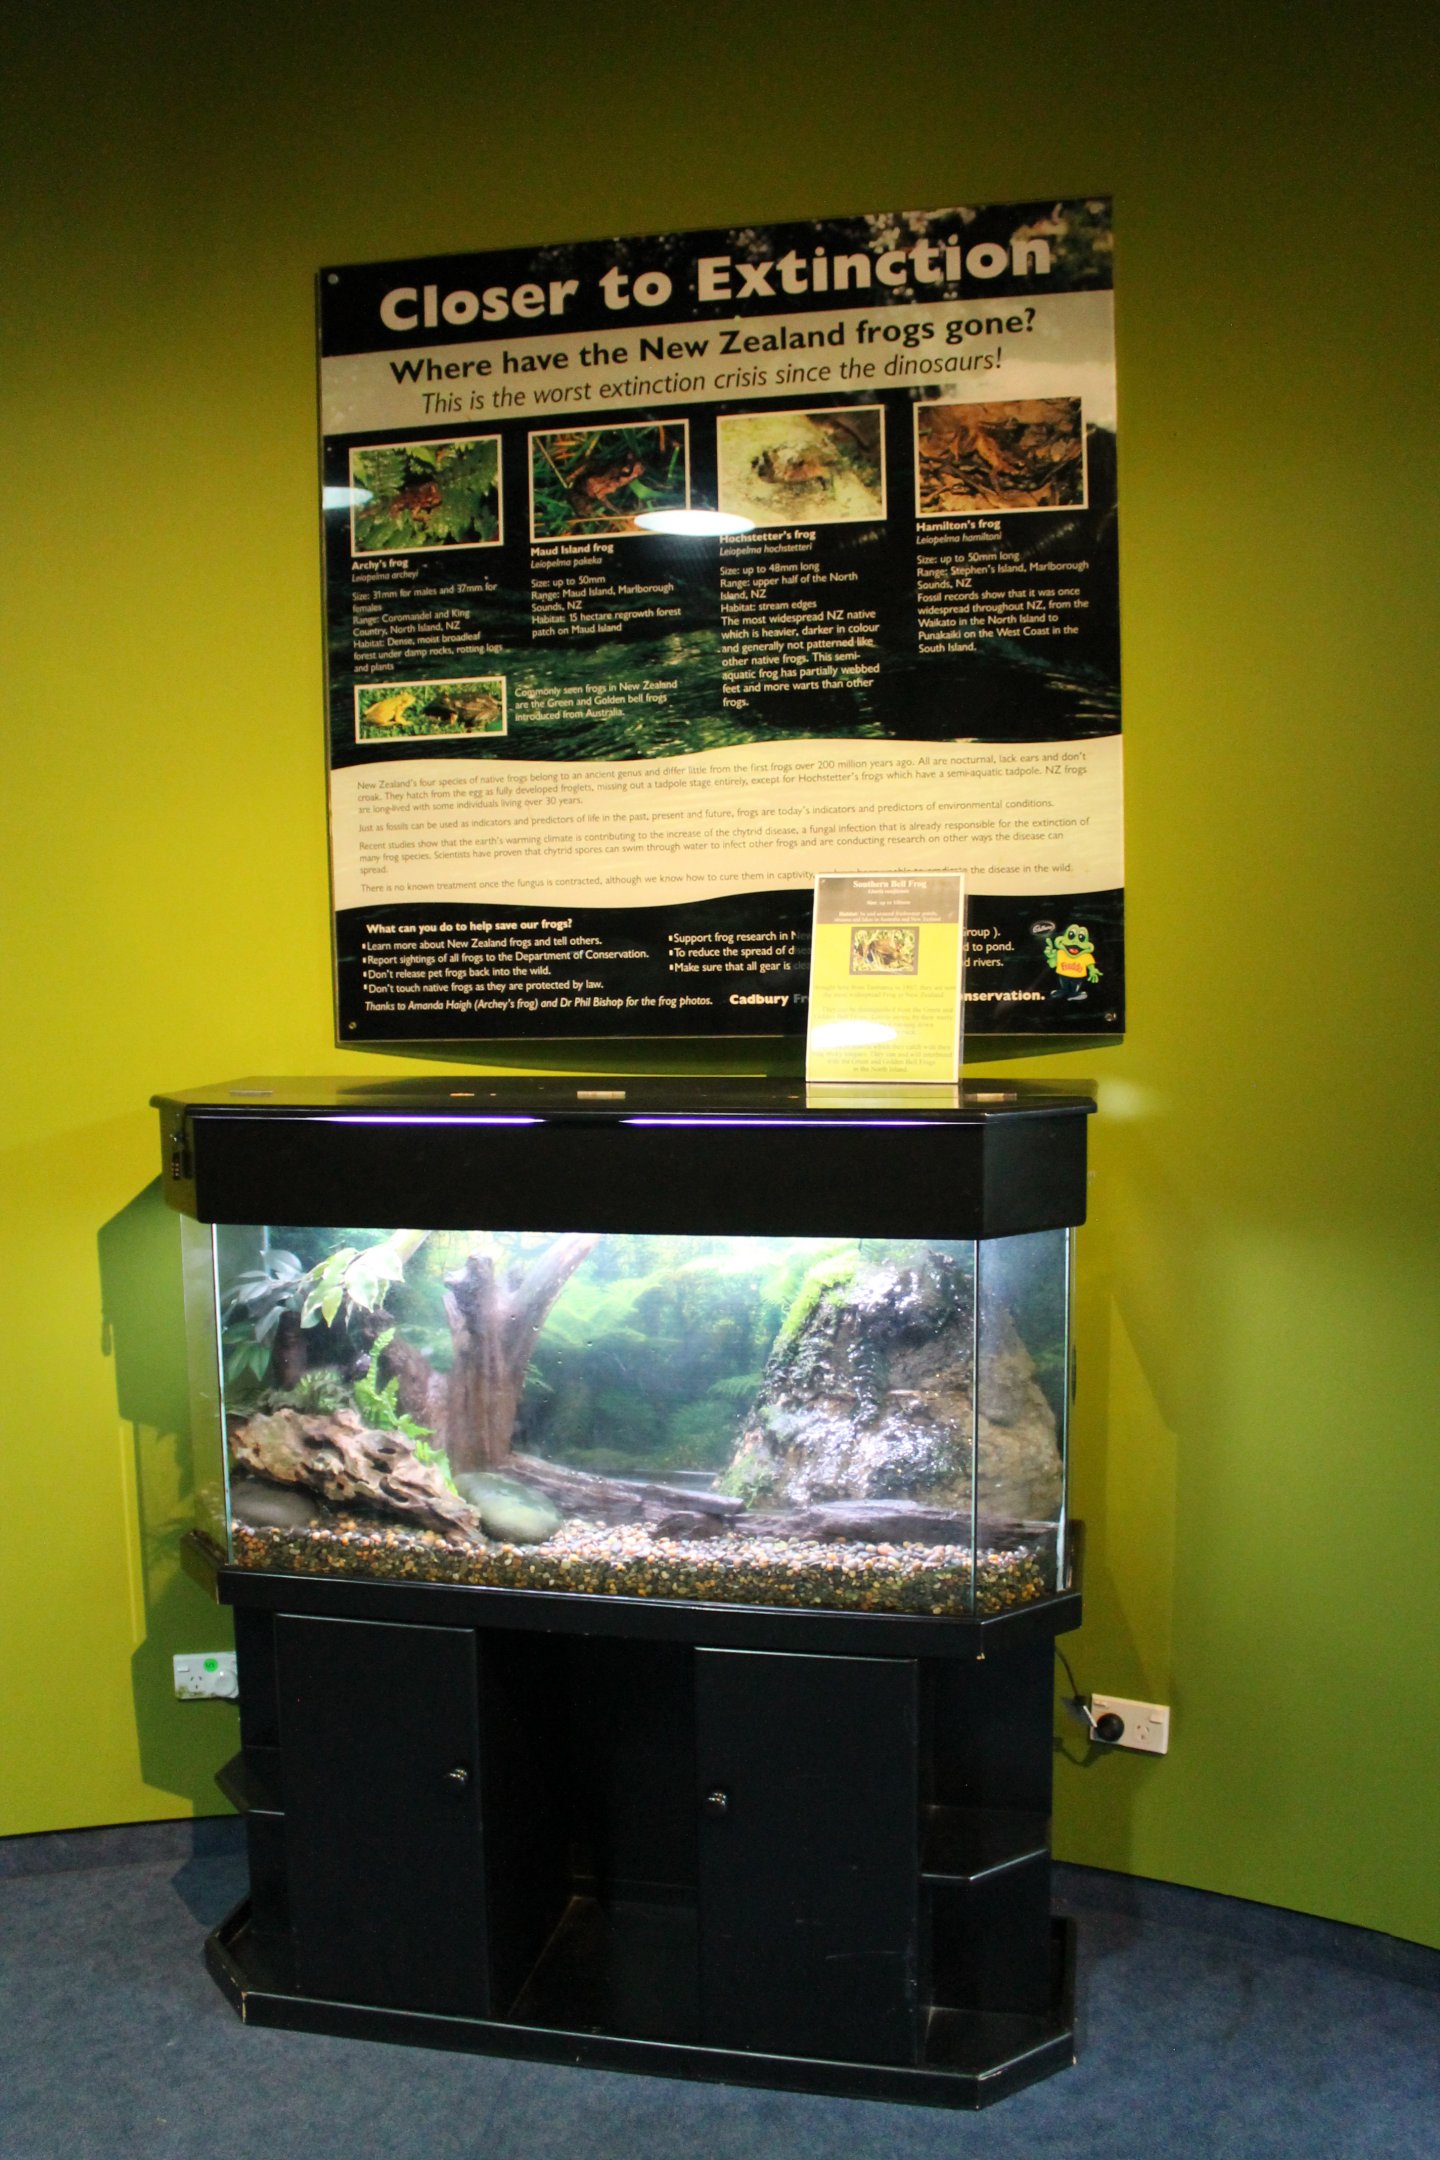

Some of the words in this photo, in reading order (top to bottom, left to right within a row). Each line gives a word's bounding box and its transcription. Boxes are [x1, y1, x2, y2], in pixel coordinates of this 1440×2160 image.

[380, 282, 578, 329] Closer
[599, 269, 671, 310] to
[697, 241, 1050, 301] Extinction
[390, 355, 491, 383] Where
[502, 347, 568, 372] have
[580, 339, 627, 365] the
[640, 335, 708, 359] New
[719, 321, 844, 353] Zealand
[857, 319, 934, 347] frogs
[946, 309, 1035, 345] gone?
[424, 391, 461, 413] This
[470, 390, 484, 409] is
[493, 387, 525, 407] the
[534, 380, 591, 404] worst
[599, 373, 705, 399] extinction
[714, 368, 766, 390] crisis
[776, 365, 830, 385] since
[840, 360, 875, 381] the
[884, 350, 1001, 377] dinosaurs!
[916, 520, 975, 532] Hamilton's
[978, 520, 1000, 531] frog
[719, 530, 791, 543] Hochstetter's
[794, 530, 815, 541] frog
[530, 546, 558, 556] Maud
[561, 544, 590, 554] Island
[593, 544, 613, 554] frog
[940, 556, 952, 565] up
[954, 553, 964, 562] to
[968, 552, 997, 562] 50mm
[999, 551, 1019, 562] long
[742, 566, 754, 576] up
[756, 564, 766, 573] to
[768, 563, 798, 572] 48mm
[800, 561, 819, 573] long
[552, 579, 564, 588] up
[566, 577, 575, 585] to
[578, 576, 605, 584] 50mm
[752, 577, 779, 588] upper
[781, 574, 798, 584] half
[800, 573, 810, 583] of
[812, 573, 826, 582] the
[829, 571, 858, 581] North
[562, 588, 586, 598] Maud
[618, 583, 674, 595] Marlborough
[569, 613, 577, 622] 15
[580, 612, 612, 621] hectare
[614, 608, 654, 621] regrowth
[656, 607, 681, 617] forest
[721, 616, 739, 626] The
[742, 614, 766, 625] most
[769, 612, 824, 625] widespread
[826, 611, 844, 621] NZ
[846, 610, 875, 620] native
[721, 629, 749, 639] which
[752, 629, 759, 638] is
[801, 625, 833, 635] darker
[836, 624, 845, 634] in
[848, 623, 879, 633] colour
[918, 643, 945, 653] South
[514, 686, 560, 697] Commonly
[585, 684, 606, 695] frogs
[608, 683, 616, 692] in
[619, 682, 640, 691] New
[643, 680, 677, 690] Zealand
[366, 924, 395, 933] What
[398, 925, 416, 933] can
[418, 925, 437, 935] you
[439, 922, 453, 931] do
[455, 922, 467, 931] to
[469, 921, 492, 933] help
[541, 919, 572, 931] frogs?
[367, 941, 391, 950] Learn
[393, 942, 416, 950] more
[419, 939, 444, 949] about
[447, 939, 468, 948] New
[471, 938, 506, 948] Zealand
[509, 937, 531, 949] frogs
[534, 936, 550, 946] and
[553, 936, 567, 945] tell
[674, 932, 711, 944] Support
[714, 932, 734, 943] frog
[736, 931, 776, 940] research
[779, 931, 788, 939] in
[674, 948, 685, 957] To
[688, 947, 720, 956] reduce
[722, 947, 738, 956] the
[741, 946, 772, 958] spread
[775, 945, 786, 954] of
[972, 943, 983, 952] to
[368, 969, 393, 978] Don't
[395, 968, 425, 978] release
[428, 968, 442, 980] pet
[445, 968, 466, 979] frogs
[469, 967, 489, 976] back
[492, 966, 510, 976] into
[512, 966, 527, 976] the
[675, 962, 699, 972] Make
[725, 962, 743, 971] that
[746, 961, 757, 970] all
[759, 963, 780, 973] gear
[783, 961, 791, 970] is
[729, 995, 788, 1006] Cadbury
[962, 990, 1046, 1001] nservation.
[365, 1001, 394, 1011] Thanks
[397, 1001, 406, 1010] to
[408, 1000, 443, 1010] Amanda
[446, 1000, 472, 1012] Haigh
[474, 999, 514, 1011] (Archey's
[517, 998, 538, 1010] frog)
[540, 998, 558, 1008] and
[560, 998, 572, 1007] Dr
[574, 998, 590, 1007] Phil
[593, 997, 623, 1009] Bishop
[626, 997, 638, 1006] for
[641, 997, 656, 1006] the
[658, 996, 676, 1008] frog
